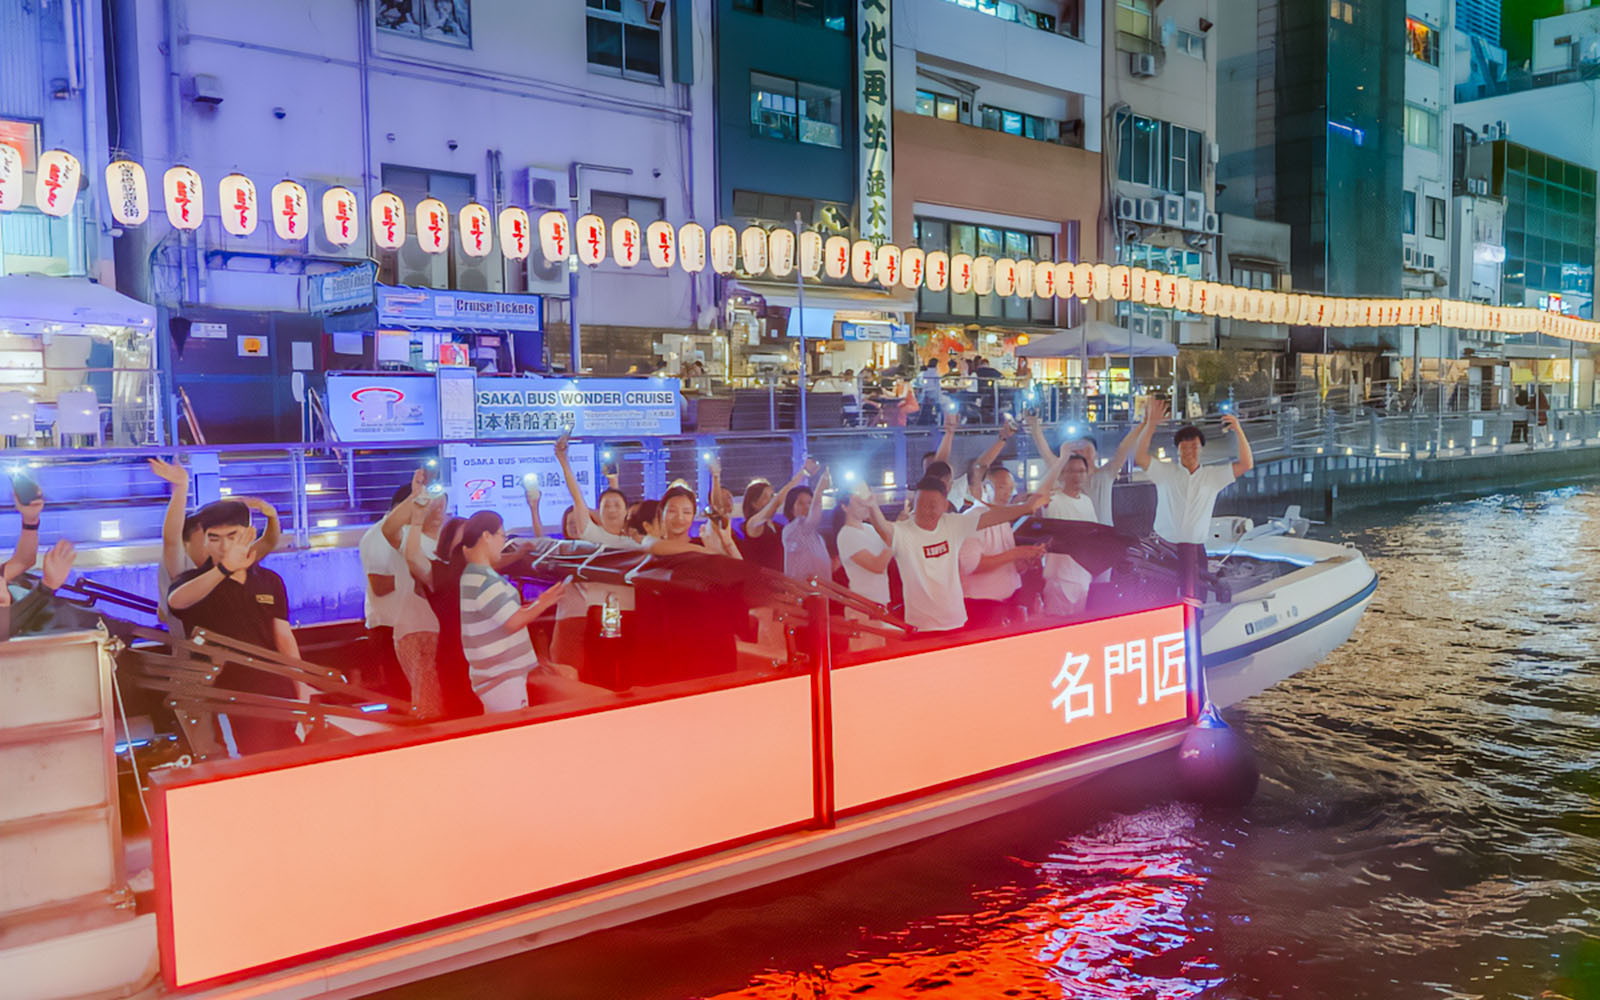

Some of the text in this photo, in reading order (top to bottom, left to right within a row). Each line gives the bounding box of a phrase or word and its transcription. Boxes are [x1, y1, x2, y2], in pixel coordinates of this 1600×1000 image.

[456, 300, 535, 314] Cruise Tickets
[477, 392, 673, 405] SAKA BUS WONDER CRUISE
[1051, 631, 1186, 724] 名門匠
